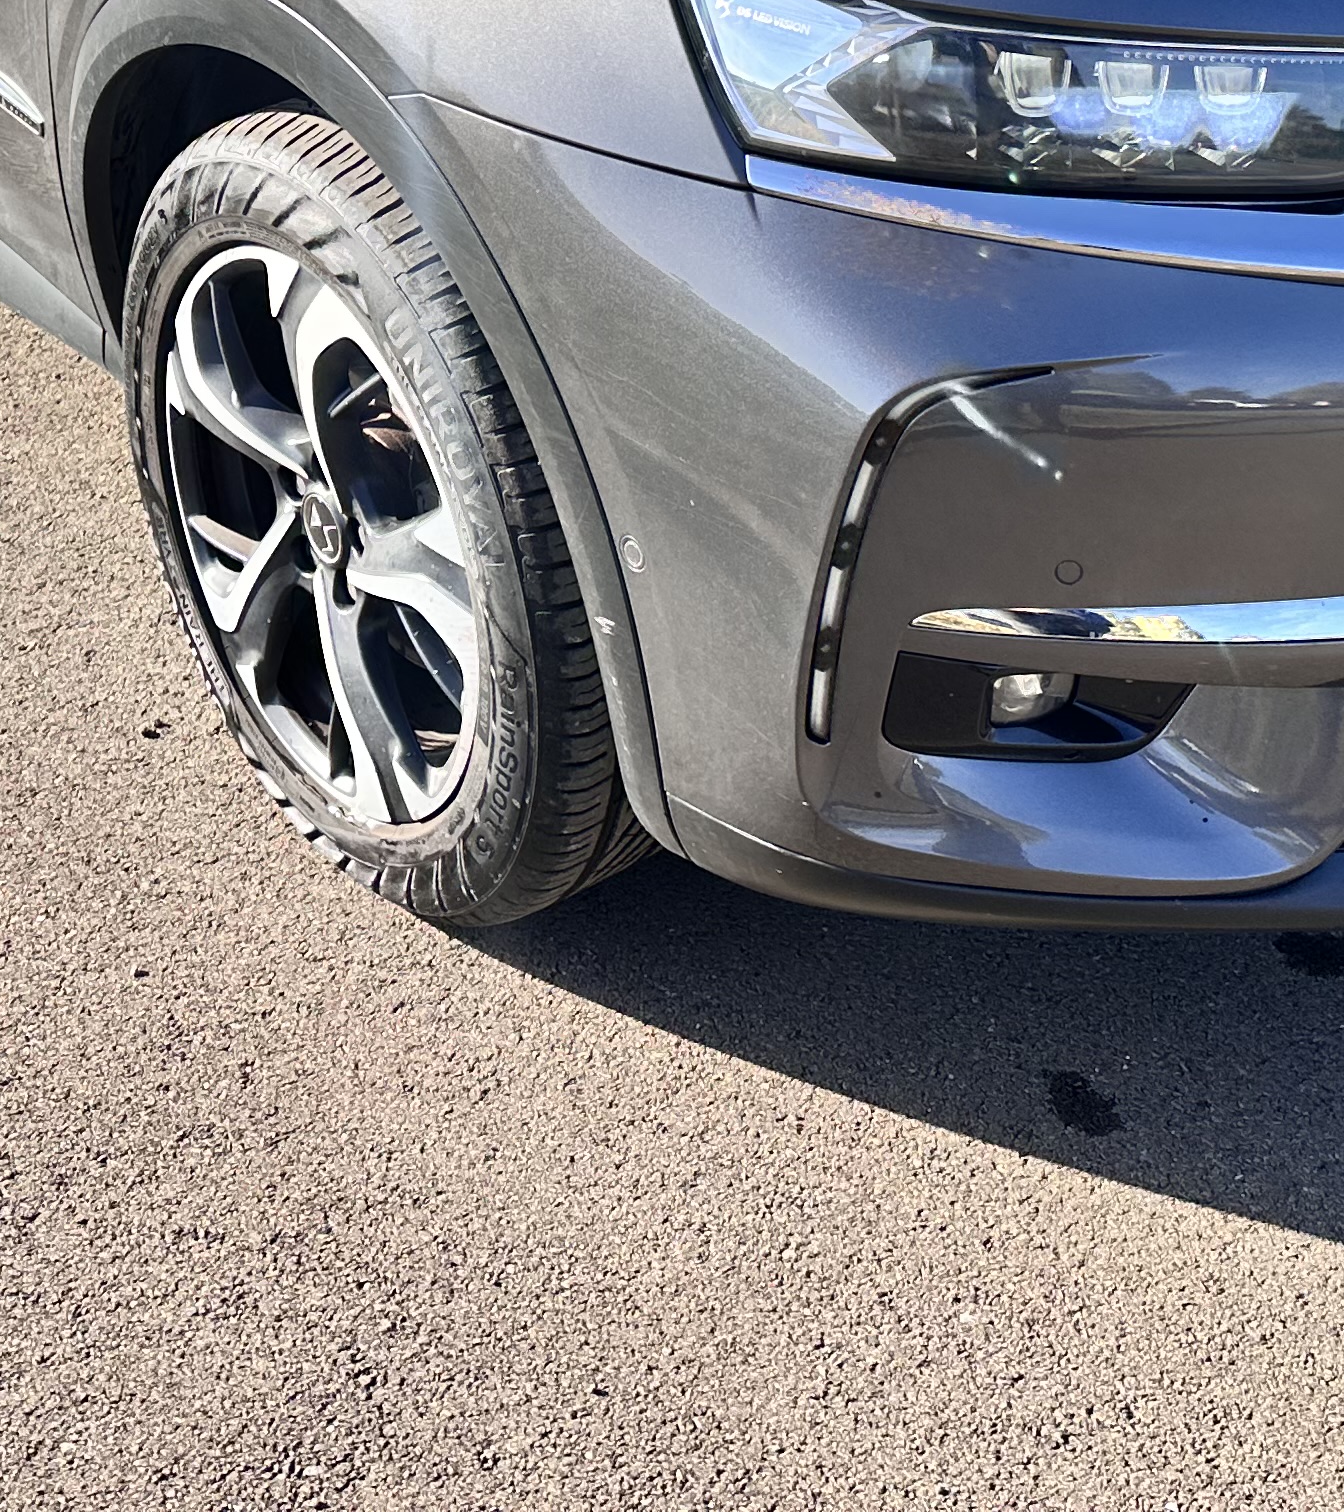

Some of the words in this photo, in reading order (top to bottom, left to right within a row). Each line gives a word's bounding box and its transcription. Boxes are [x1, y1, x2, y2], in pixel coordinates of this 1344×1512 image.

[752, 9, 773, 24] LED
[773, 15, 811, 36] VISION
[384, 307, 506, 567] UNIROYAL
[484, 660, 522, 838] RainSport
[474, 837, 496, 862] 5
